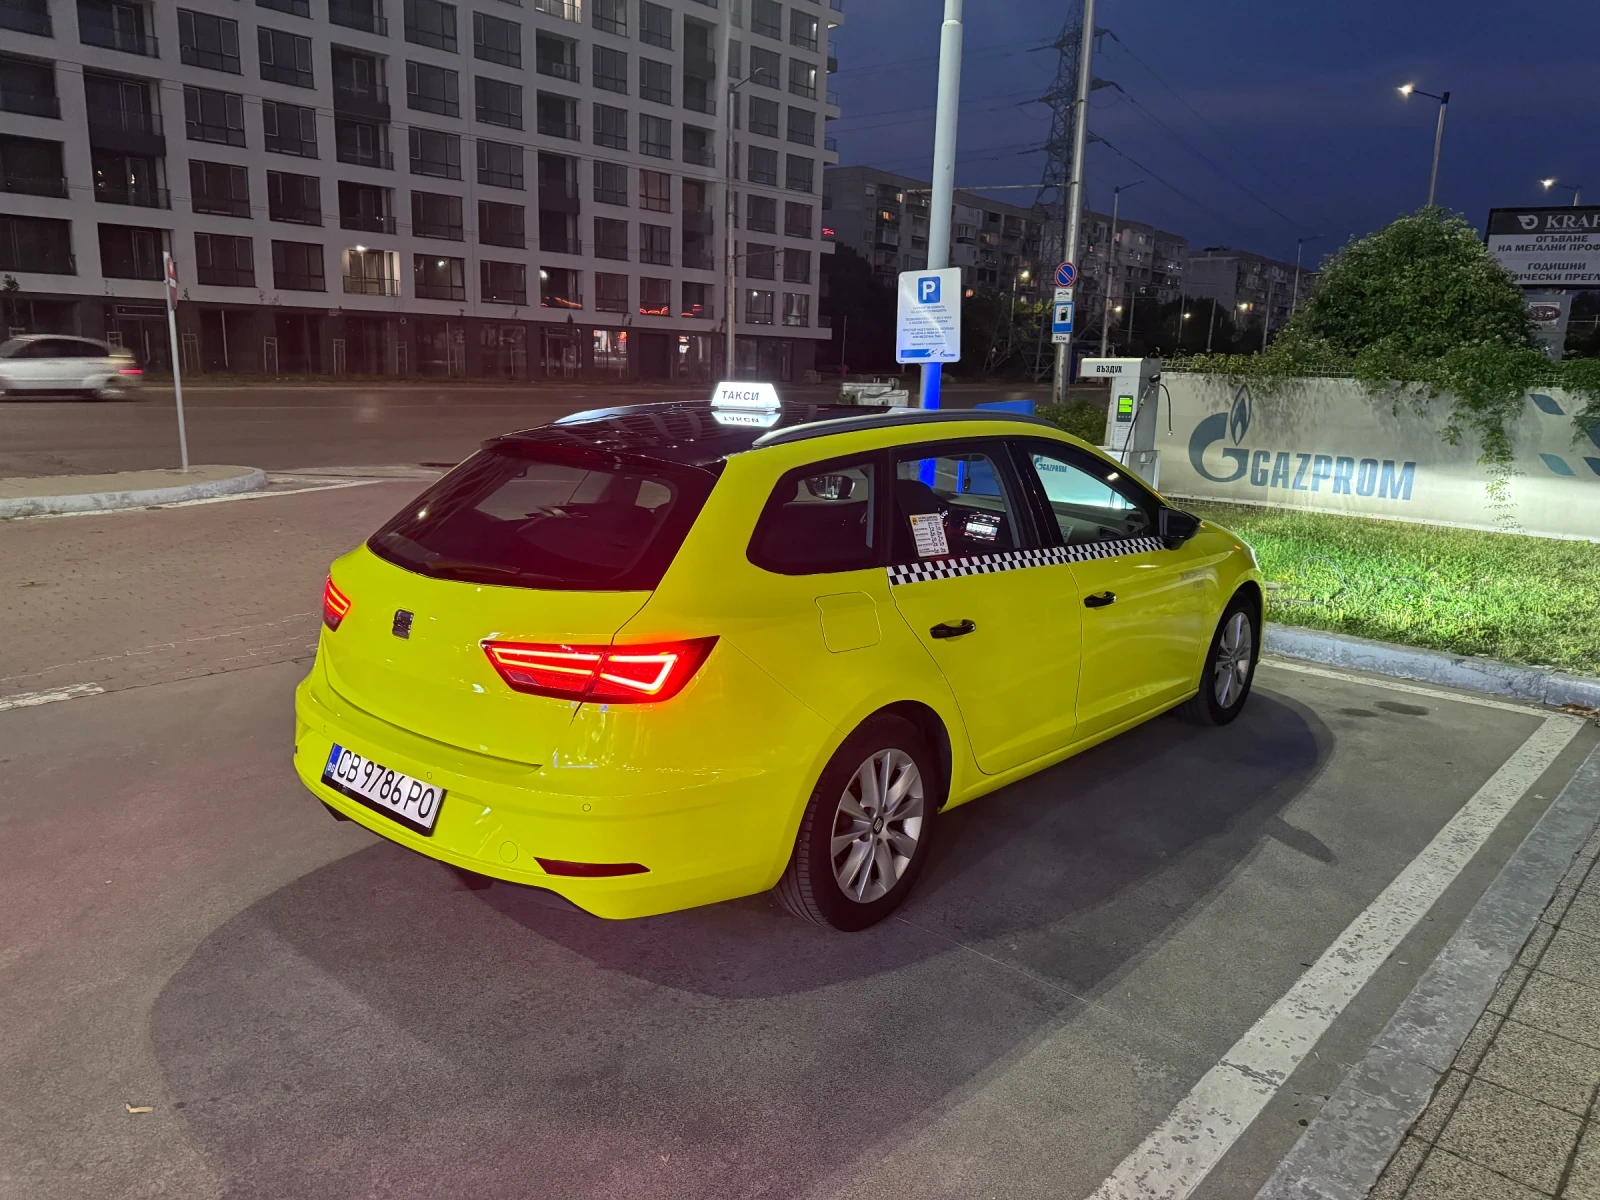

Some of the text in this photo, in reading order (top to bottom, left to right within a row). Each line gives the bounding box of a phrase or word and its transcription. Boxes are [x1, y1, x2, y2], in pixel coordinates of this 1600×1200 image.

[1498, 244, 1512, 252] НА
[1515, 244, 1566, 252] МЕТАЛНИ
[1527, 262, 1586, 271] ГОДИШНИ
[1514, 273, 1561, 281] ИЧЕСКИ
[923, 281, 936, 300] P
[1096, 365, 1123, 374] ВЪЗДУХ
[722, 390, 760, 401] ТАКСИ
[1250, 449, 1416, 501] GAZPROM
[327, 763, 336, 773] BG
[360, 761, 406, 805] 9786
